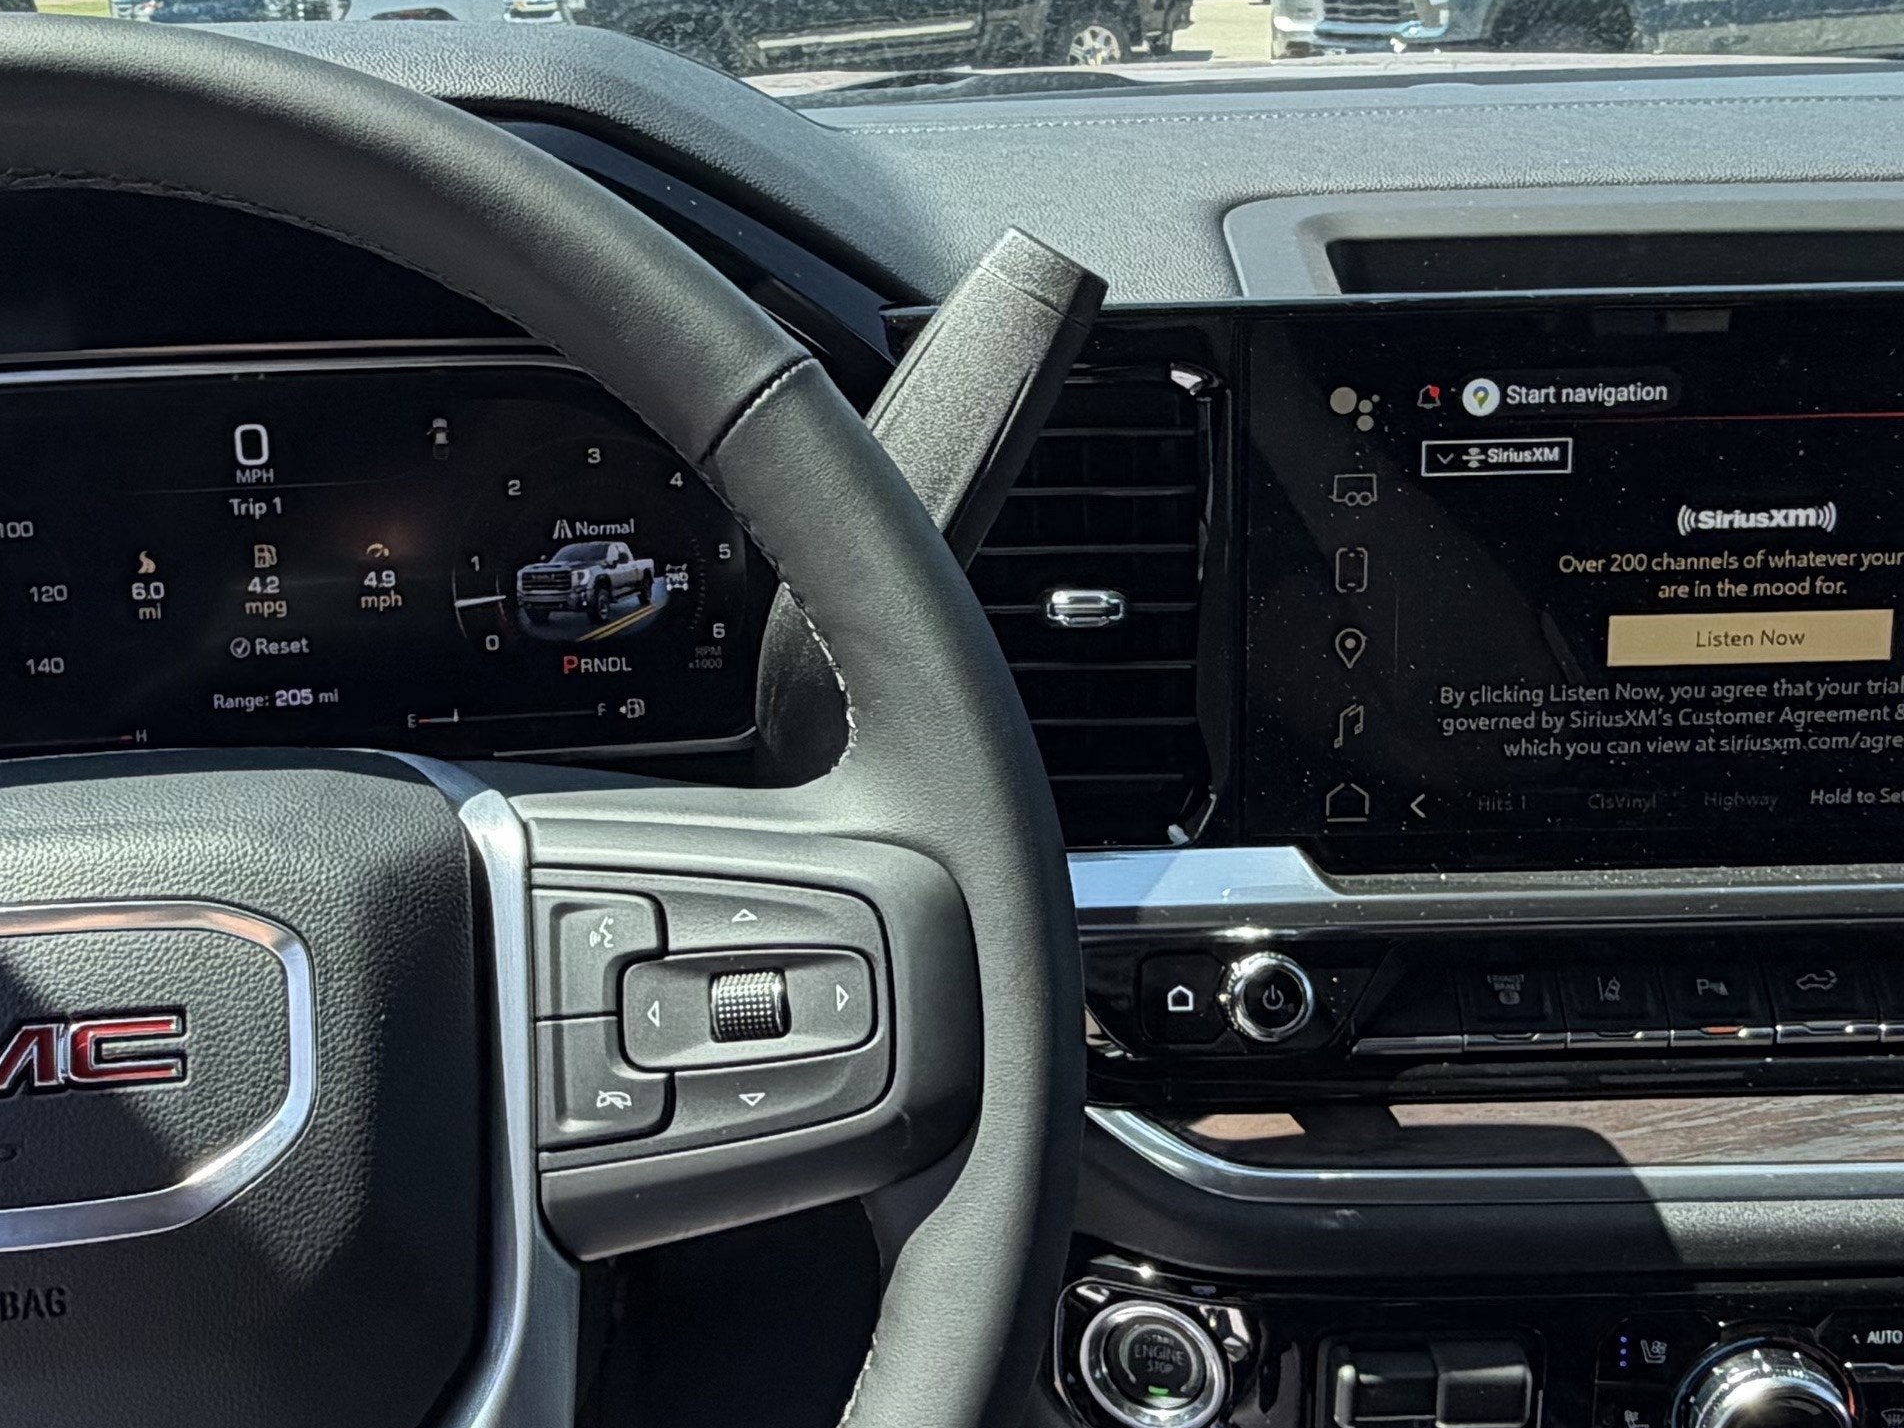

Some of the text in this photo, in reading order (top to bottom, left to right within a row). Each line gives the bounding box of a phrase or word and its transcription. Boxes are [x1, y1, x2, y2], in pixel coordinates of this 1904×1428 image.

[1506, 382, 1669, 407] Start navigation
[234, 424, 269, 466] 0
[587, 447, 601, 464] 3
[1487, 445, 1561, 465] SiriusXM
[236, 468, 274, 484] MPH
[669, 472, 684, 487] 4
[507, 479, 522, 496] 2
[229, 497, 283, 519] Trip 1
[575, 518, 635, 537] Normal
[718, 543, 732, 560] 5
[470, 555, 481, 572] 1
[1559, 554, 1606, 574] Over
[1610, 553, 1647, 573] 200
[1652, 551, 1738, 572] channels
[1743, 549, 1766, 569] of
[1769, 549, 1857, 569] whatever
[1859, 551, 1904, 572] your
[247, 575, 281, 594] 4.2
[363, 569, 397, 588] 4.9
[1658, 576, 1848, 600] are in the mood for.
[29, 584, 68, 603] 120
[131, 581, 165, 600] 6.0
[245, 599, 288, 618] mpg
[360, 590, 403, 612] mph
[139, 602, 162, 620] mi
[712, 622, 725, 639] 6
[1696, 629, 1806, 648] Listen Now
[255, 637, 310, 655] Reset
[485, 634, 500, 651] 0
[26, 657, 65, 675] 140
[213, 688, 339, 712] Range: 205 mi
[1439, 686, 1464, 709] By
[1469, 684, 1544, 708] clicking
[1549, 683, 1610, 703] Listen
[1614, 682, 1665, 703] Now,
[1669, 685, 1706, 705] you
[1710, 683, 1768, 704] agree
[1773, 678, 1814, 697] that
[1816, 679, 1863, 701] your
[1441, 711, 1536, 737] governed
[1541, 711, 1566, 734] by
[1569, 708, 1674, 728] SiriusXM's
[1678, 706, 1775, 726] Customer
[1778, 704, 1892, 729] Agreement
[1503, 738, 1562, 757] which
[1564, 740, 1602, 761] you
[1606, 740, 1642, 755] can
[1646, 735, 1691, 754] view
[1696, 735, 1717, 753] at
[1809, 788, 1852, 805] Hold
[1856, 789, 1876, 804] to
[1866, 1329, 1904, 1345] AUTO
